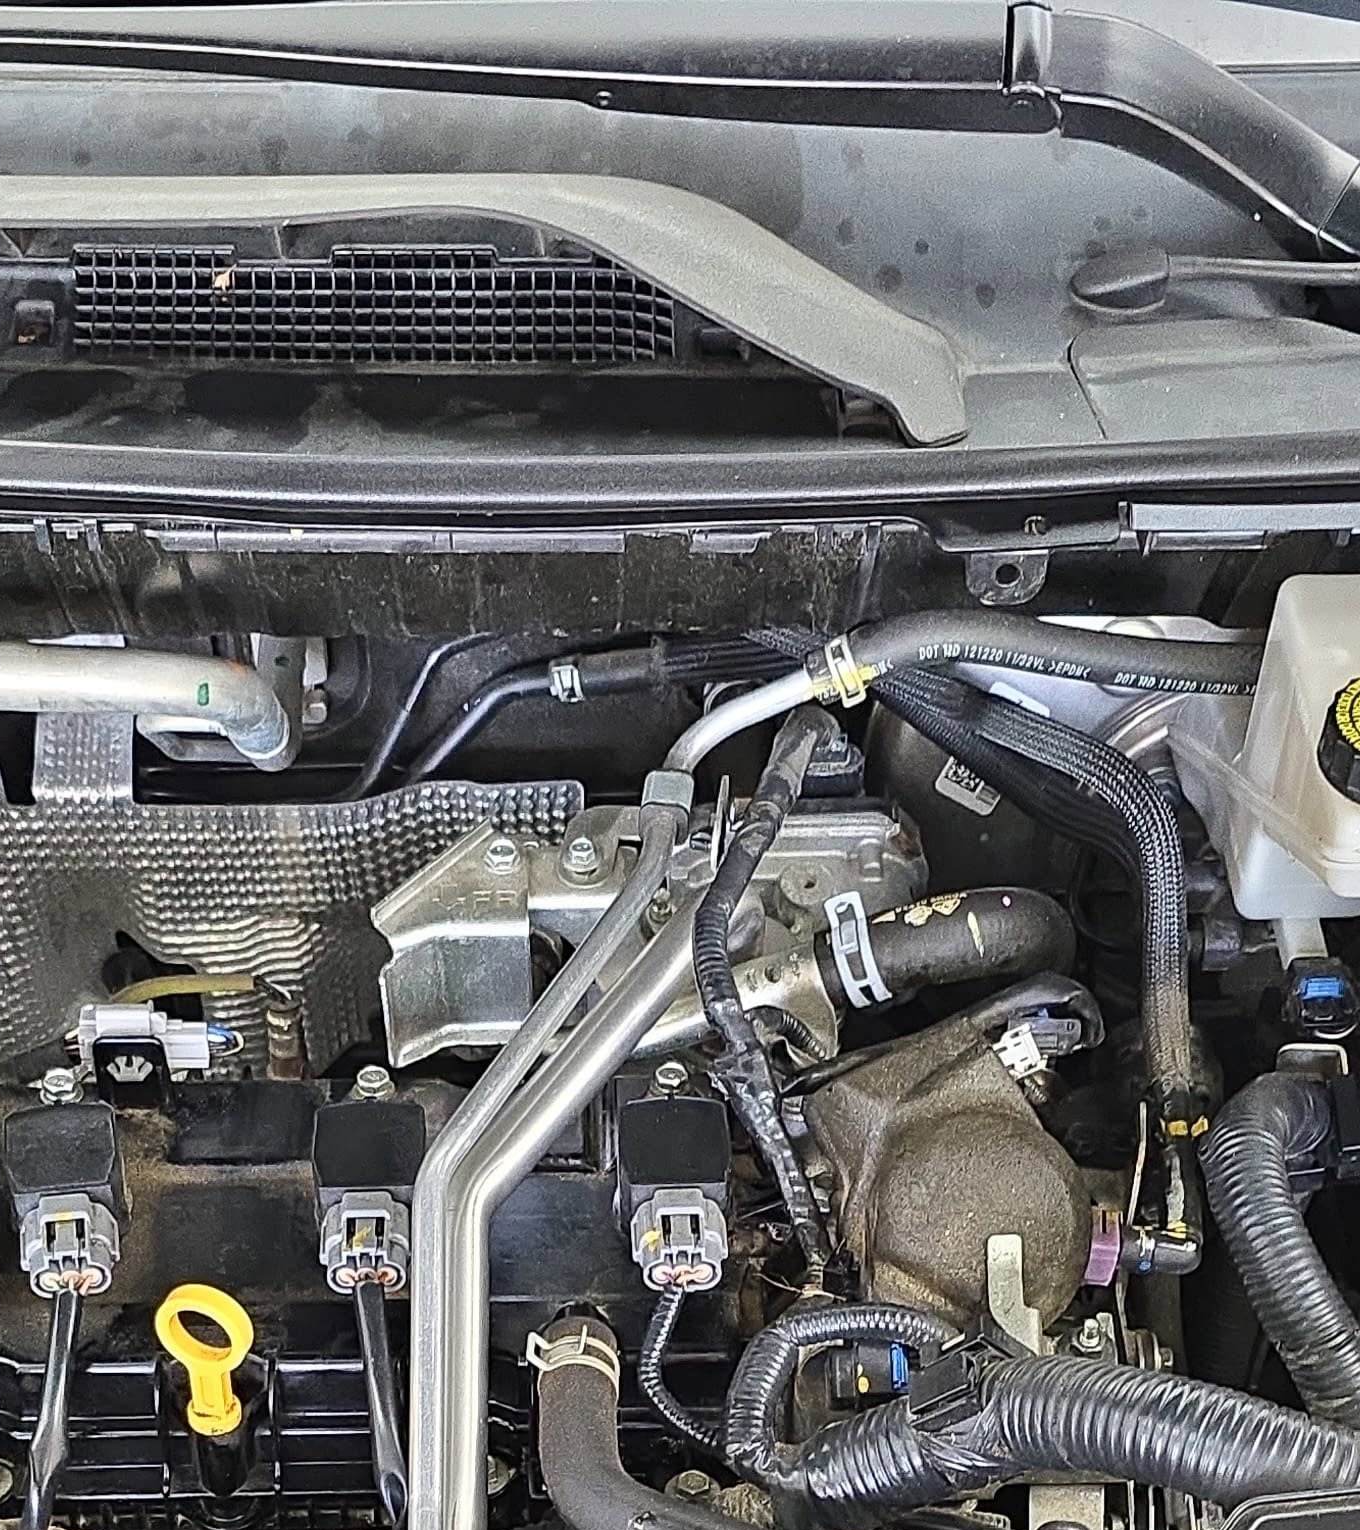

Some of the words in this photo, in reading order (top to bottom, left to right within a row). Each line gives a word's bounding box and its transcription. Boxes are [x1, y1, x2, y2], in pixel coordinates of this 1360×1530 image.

[919, 644, 940, 661] DOT
[963, 644, 1003, 663] 121220
[1114, 671, 1137, 685] DOT
